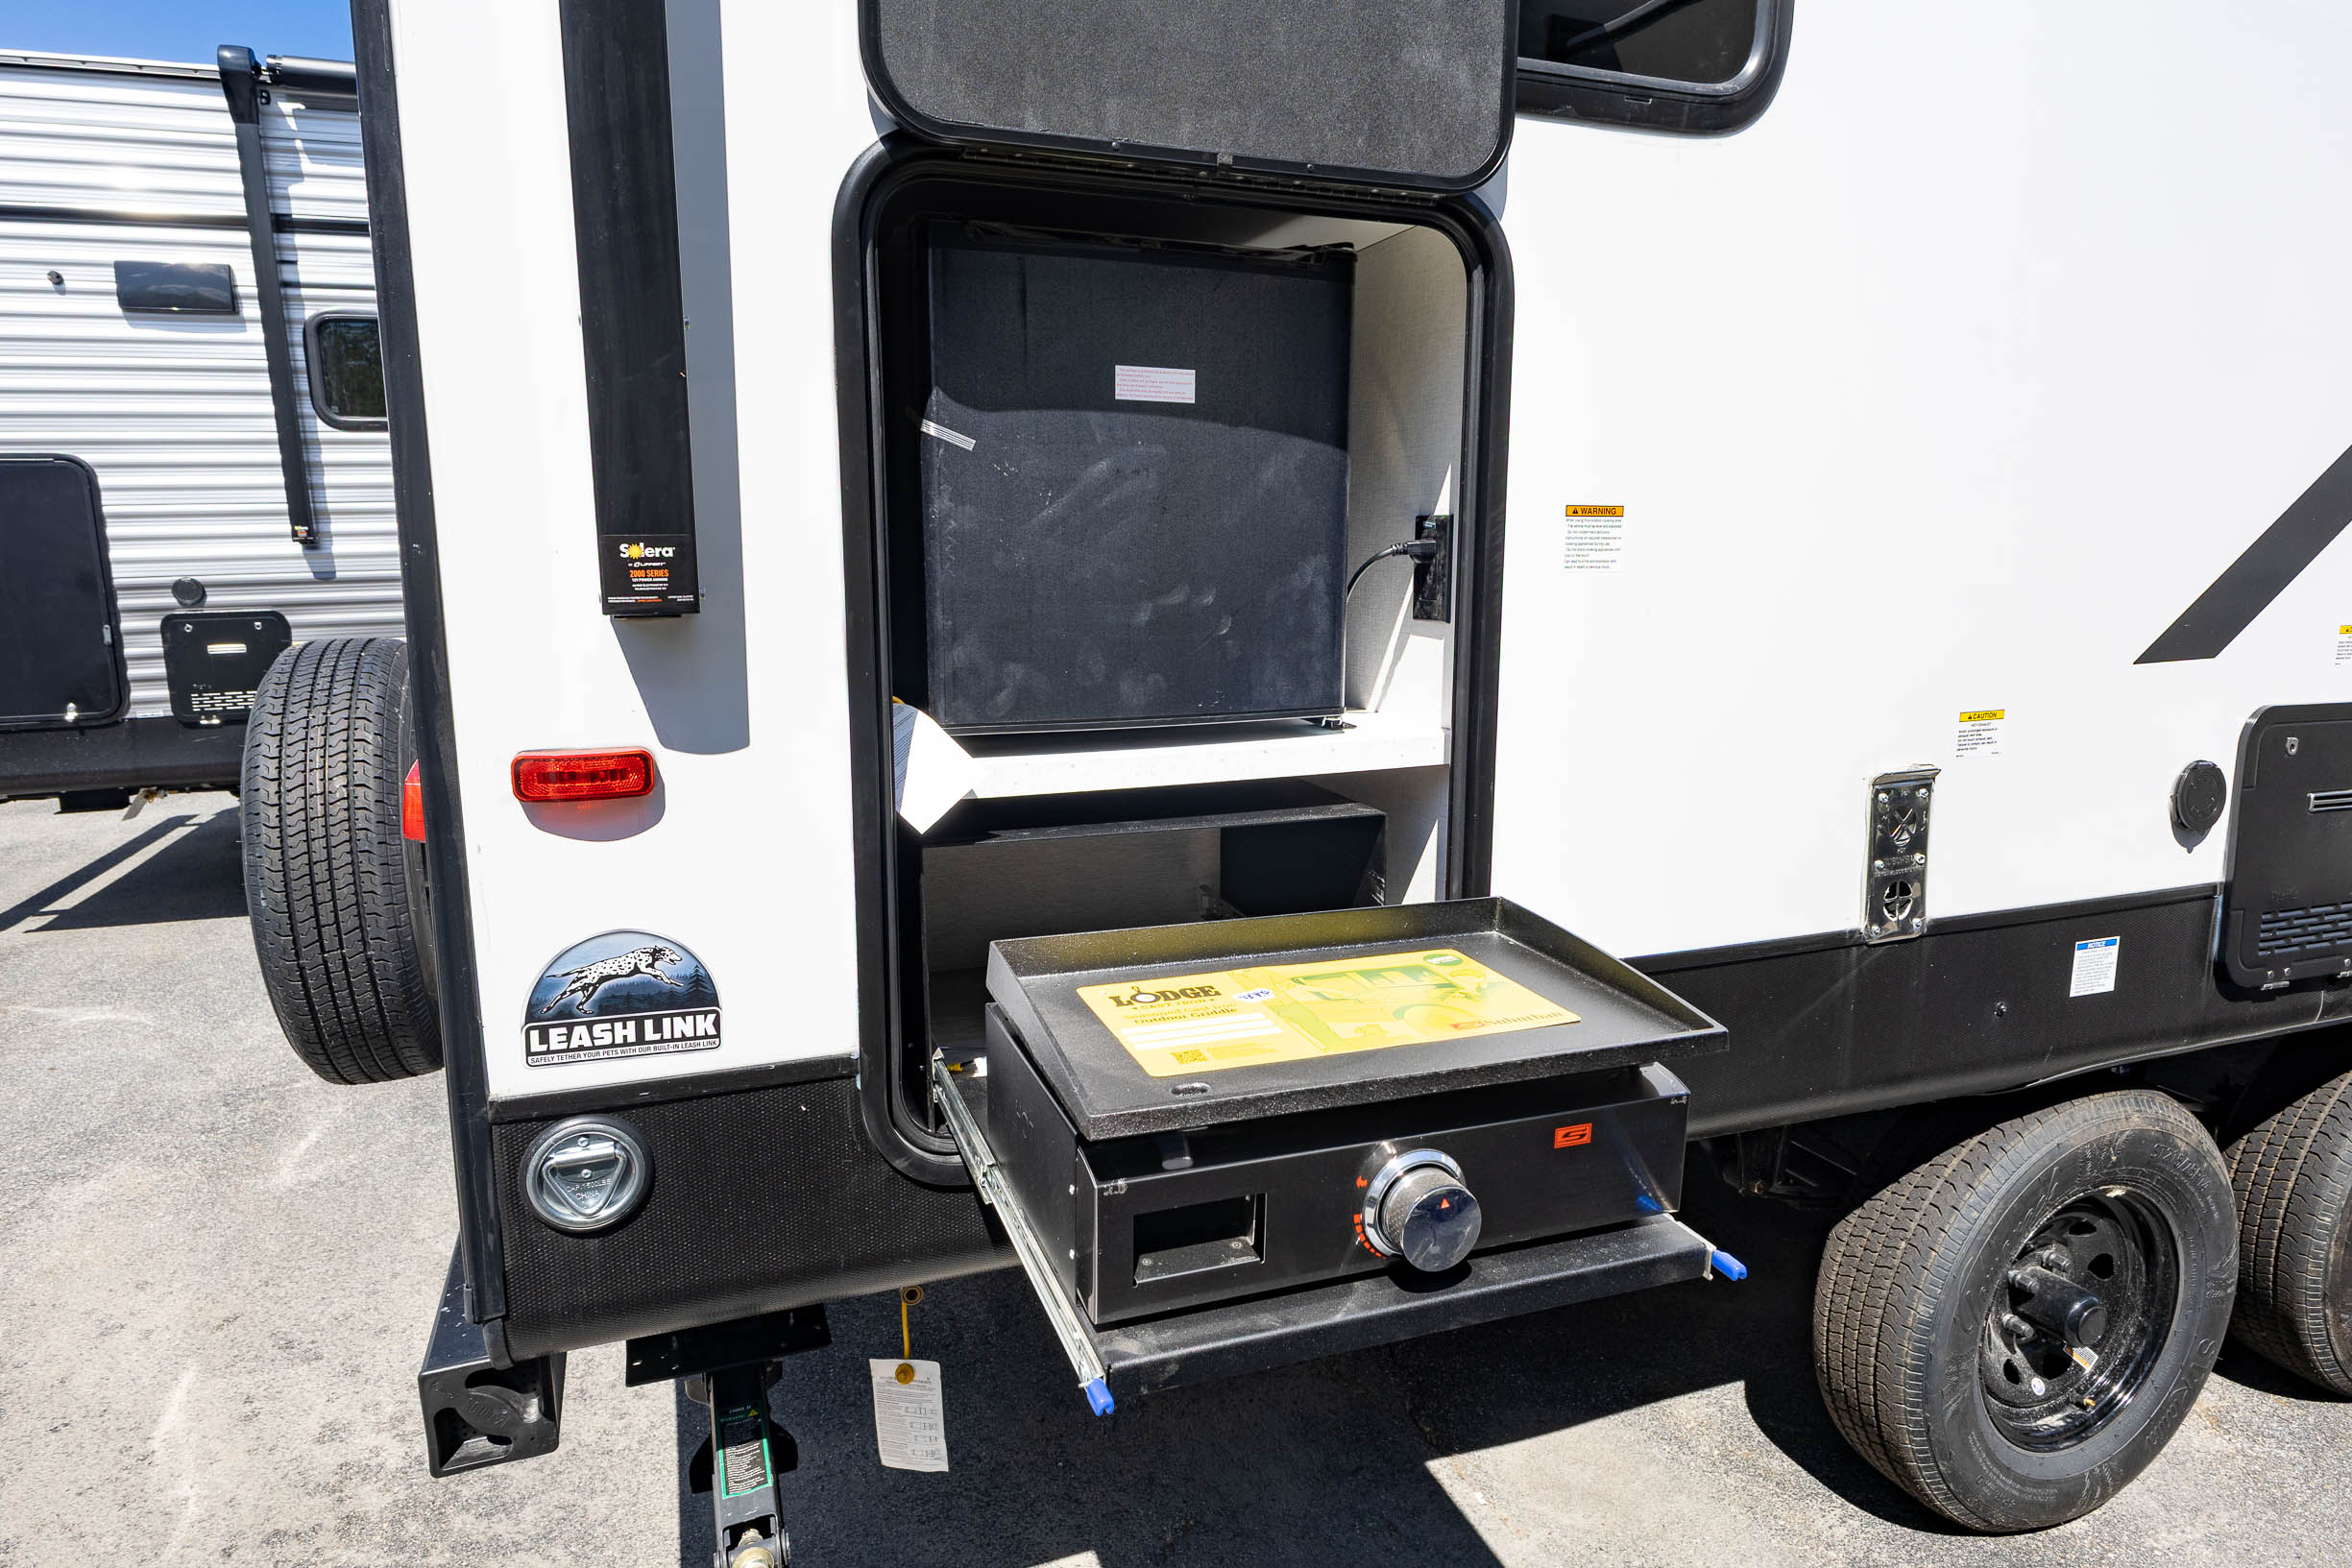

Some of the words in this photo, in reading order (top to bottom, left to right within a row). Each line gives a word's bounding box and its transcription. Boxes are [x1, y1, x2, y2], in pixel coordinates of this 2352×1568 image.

[619, 543, 675, 558] Solera
[630, 569, 645, 578] 2000
[1108, 984, 1222, 1007] LODGE
[1134, 1014, 1187, 1024] Outdoor
[1190, 1008, 1237, 1018] Griddle
[530, 1020, 636, 1053] LEASH
[643, 1014, 717, 1041] LINK
[530, 1055, 555, 1064] SAFELY
[556, 1053, 582, 1062] TETHER
[583, 1050, 601, 1059] YOUR
[653, 1043, 680, 1052] BUILT-IN
